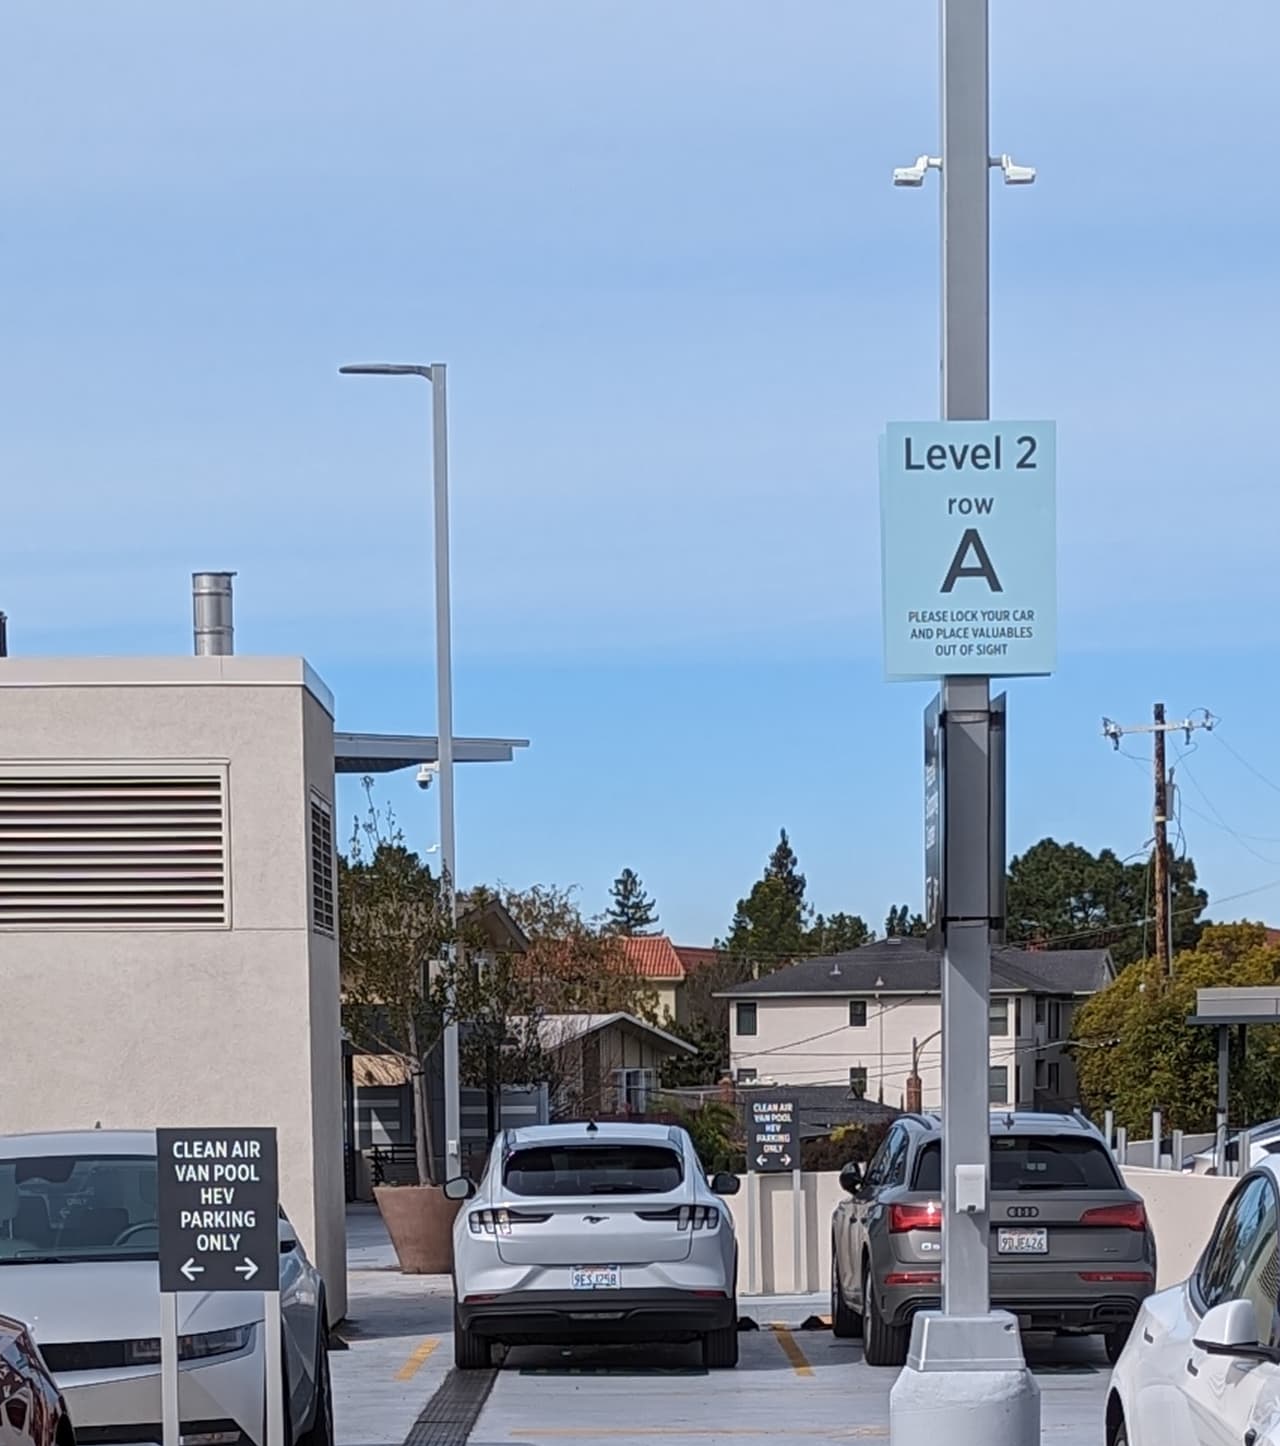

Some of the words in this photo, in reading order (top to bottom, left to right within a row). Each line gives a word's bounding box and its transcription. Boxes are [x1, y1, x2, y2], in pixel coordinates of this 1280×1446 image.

[905, 435, 1001, 470] Level
[1016, 435, 1037, 469] 2
[948, 497, 994, 515] row
[940, 528, 1003, 593] A
[908, 610, 948, 623] PLEASE
[950, 610, 977, 622] LOCK
[980, 609, 1010, 621] YOUR
[1012, 609, 1034, 621] CAR
[910, 628, 933, 640] AND
[936, 627, 969, 640] PLACE
[971, 626, 1033, 639] VALUABLES
[935, 644, 957, 656] OUT
[959, 644, 974, 656] OF
[976, 643, 1008, 656] SIGHT
[753, 1103, 778, 1112] CLEAN
[779, 1103, 793, 1112] AIR
[771, 1113, 792, 1122] POOL
[173, 1141, 227, 1158] CLEAN
[231, 1141, 261, 1158] AIR
[175, 1164, 209, 1182] VAN
[214, 1164, 260, 1181] POOL
[200, 1187, 235, 1205] HEV
[180, 1211, 256, 1228] PARKING
[196, 1234, 241, 1251] ONLY
